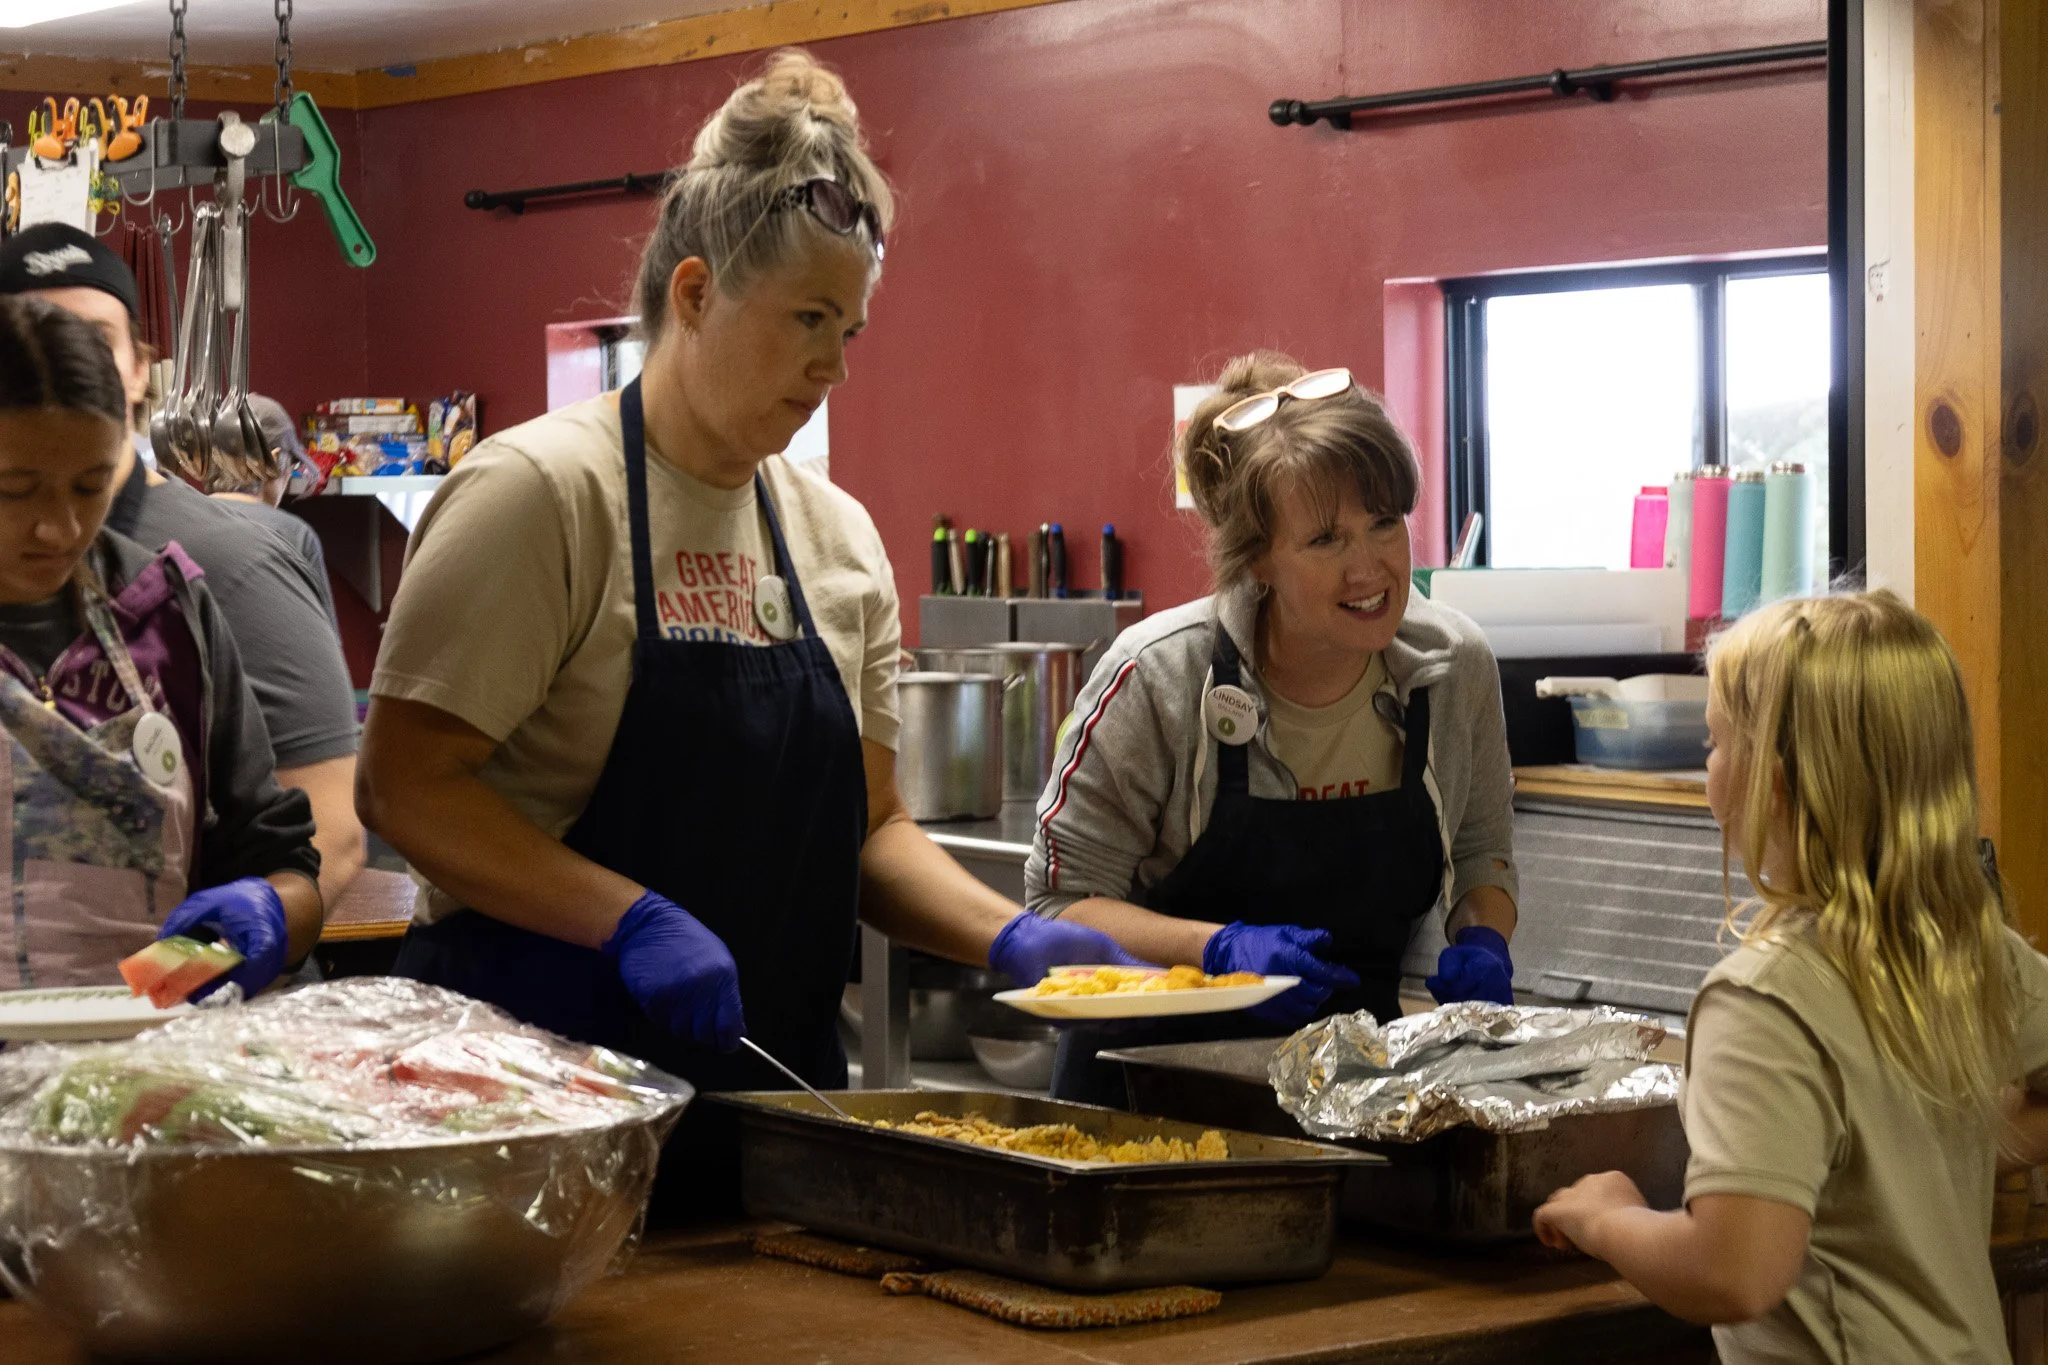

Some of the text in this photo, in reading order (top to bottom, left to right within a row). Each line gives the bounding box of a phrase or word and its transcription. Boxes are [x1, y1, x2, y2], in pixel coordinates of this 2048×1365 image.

[675, 551, 757, 594] GREAT
[657, 590, 778, 643] AMERIC
[1212, 689, 1254, 713] LINDSAY
